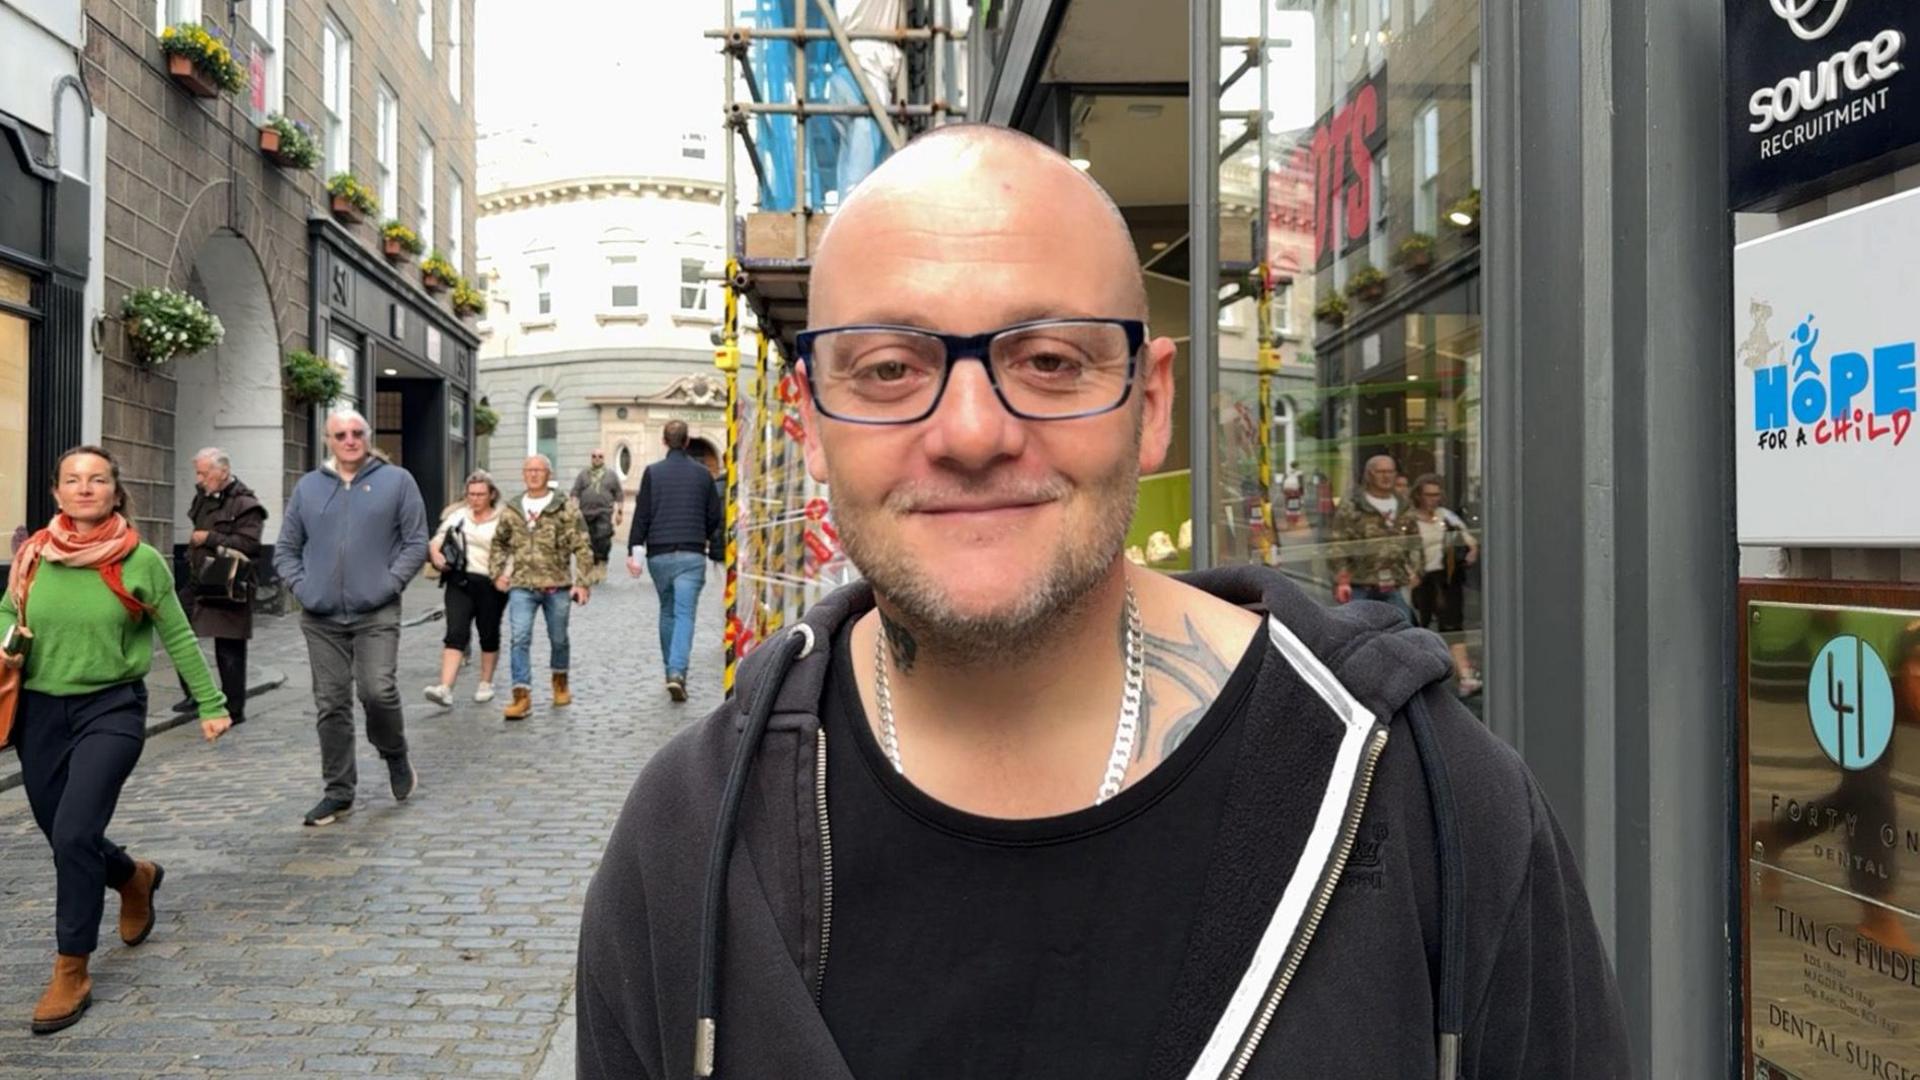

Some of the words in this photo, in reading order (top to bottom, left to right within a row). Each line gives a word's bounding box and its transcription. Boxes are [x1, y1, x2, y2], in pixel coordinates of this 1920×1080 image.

[1748, 29, 1901, 133] source
[1760, 87, 1890, 160] RECRUITMENT
[1754, 341, 1917, 431] HOPE
[1758, 429, 1788, 450] FOR
[1796, 427, 1807, 447] A
[1771, 794, 1858, 837] FORTY
[1814, 844, 1888, 879] DENTAL
[1775, 905, 1817, 947] TIM
[1826, 925, 1847, 959] G.
[1769, 1003, 1840, 1057] DENTAL
